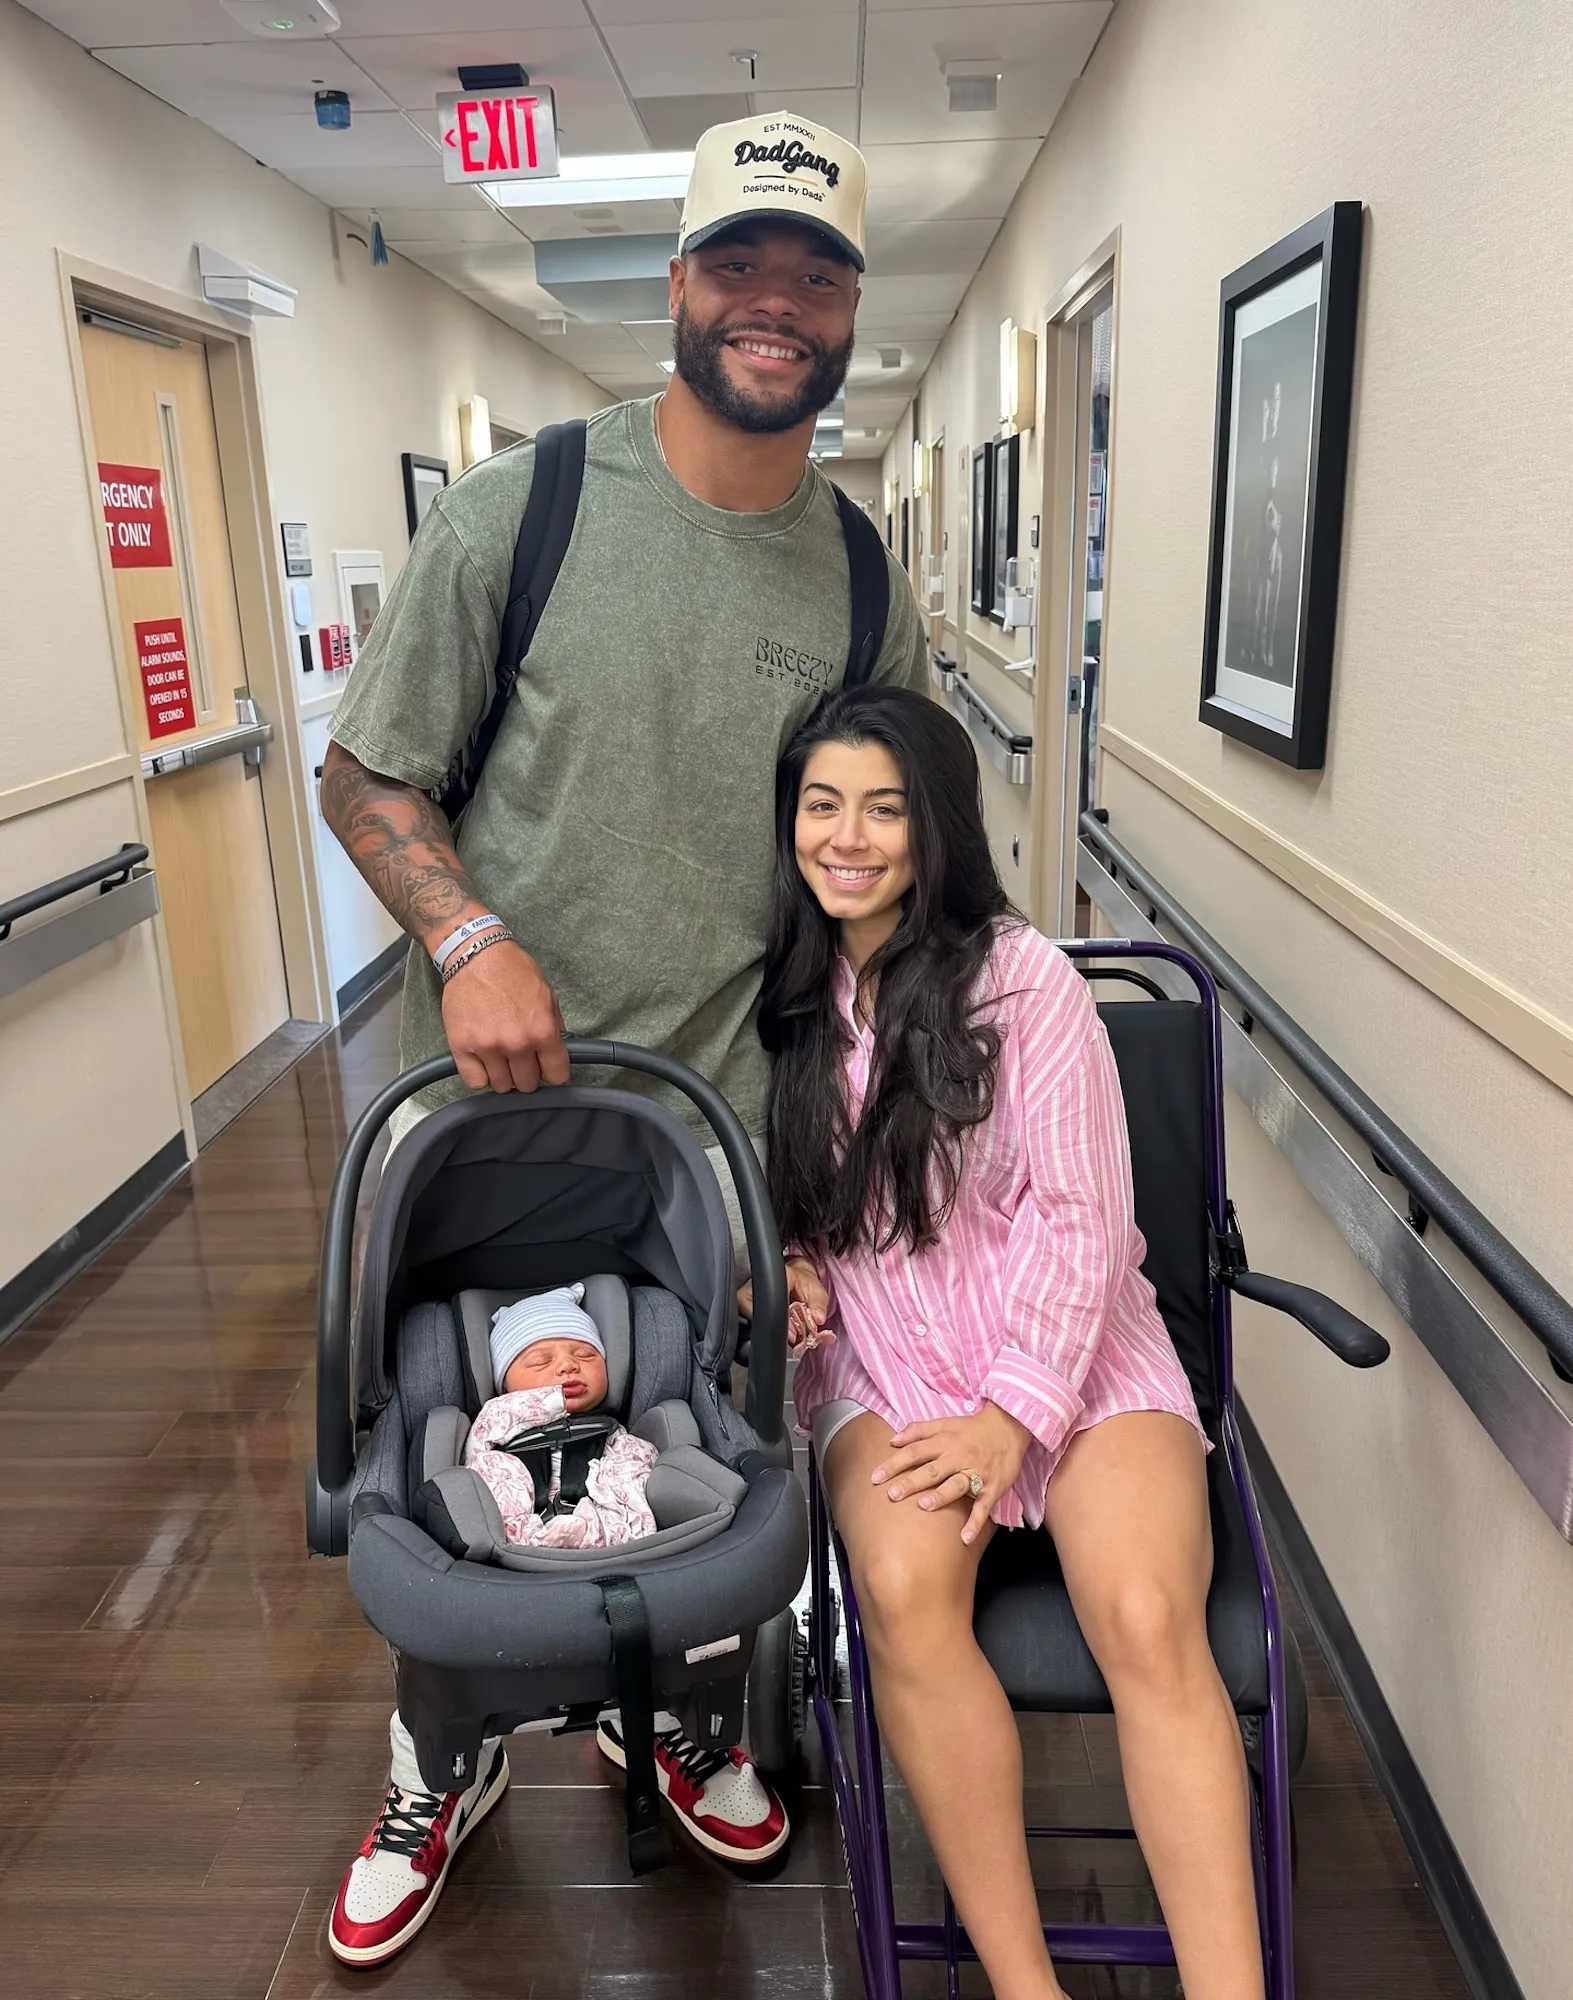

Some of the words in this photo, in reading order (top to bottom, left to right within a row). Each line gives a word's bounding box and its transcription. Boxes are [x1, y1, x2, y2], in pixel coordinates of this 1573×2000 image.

[456, 97, 539, 173] EXIT
[763, 123, 781, 133] EST
[783, 123, 816, 141] MMXXII
[734, 139, 840, 189] DadGang
[743, 184, 785, 194] Designed
[788, 185, 799, 195] by
[118, 522, 151, 546] ONLY
[144, 634, 160, 647] PUSH
[160, 632, 177, 645] UNTIL
[141, 653, 162, 668] ALARM
[755, 636, 833, 686] BREEZY
[147, 672, 164, 687] DOOR
[164, 670, 177, 684] CAN
[177, 669, 185, 682] BE
[150, 690, 172, 706] OPENED
[172, 689, 180, 701] IN
[180, 688, 188, 699] 15
[158, 708, 184, 724] SECONDS
[471, 917, 490, 928] FAITH
